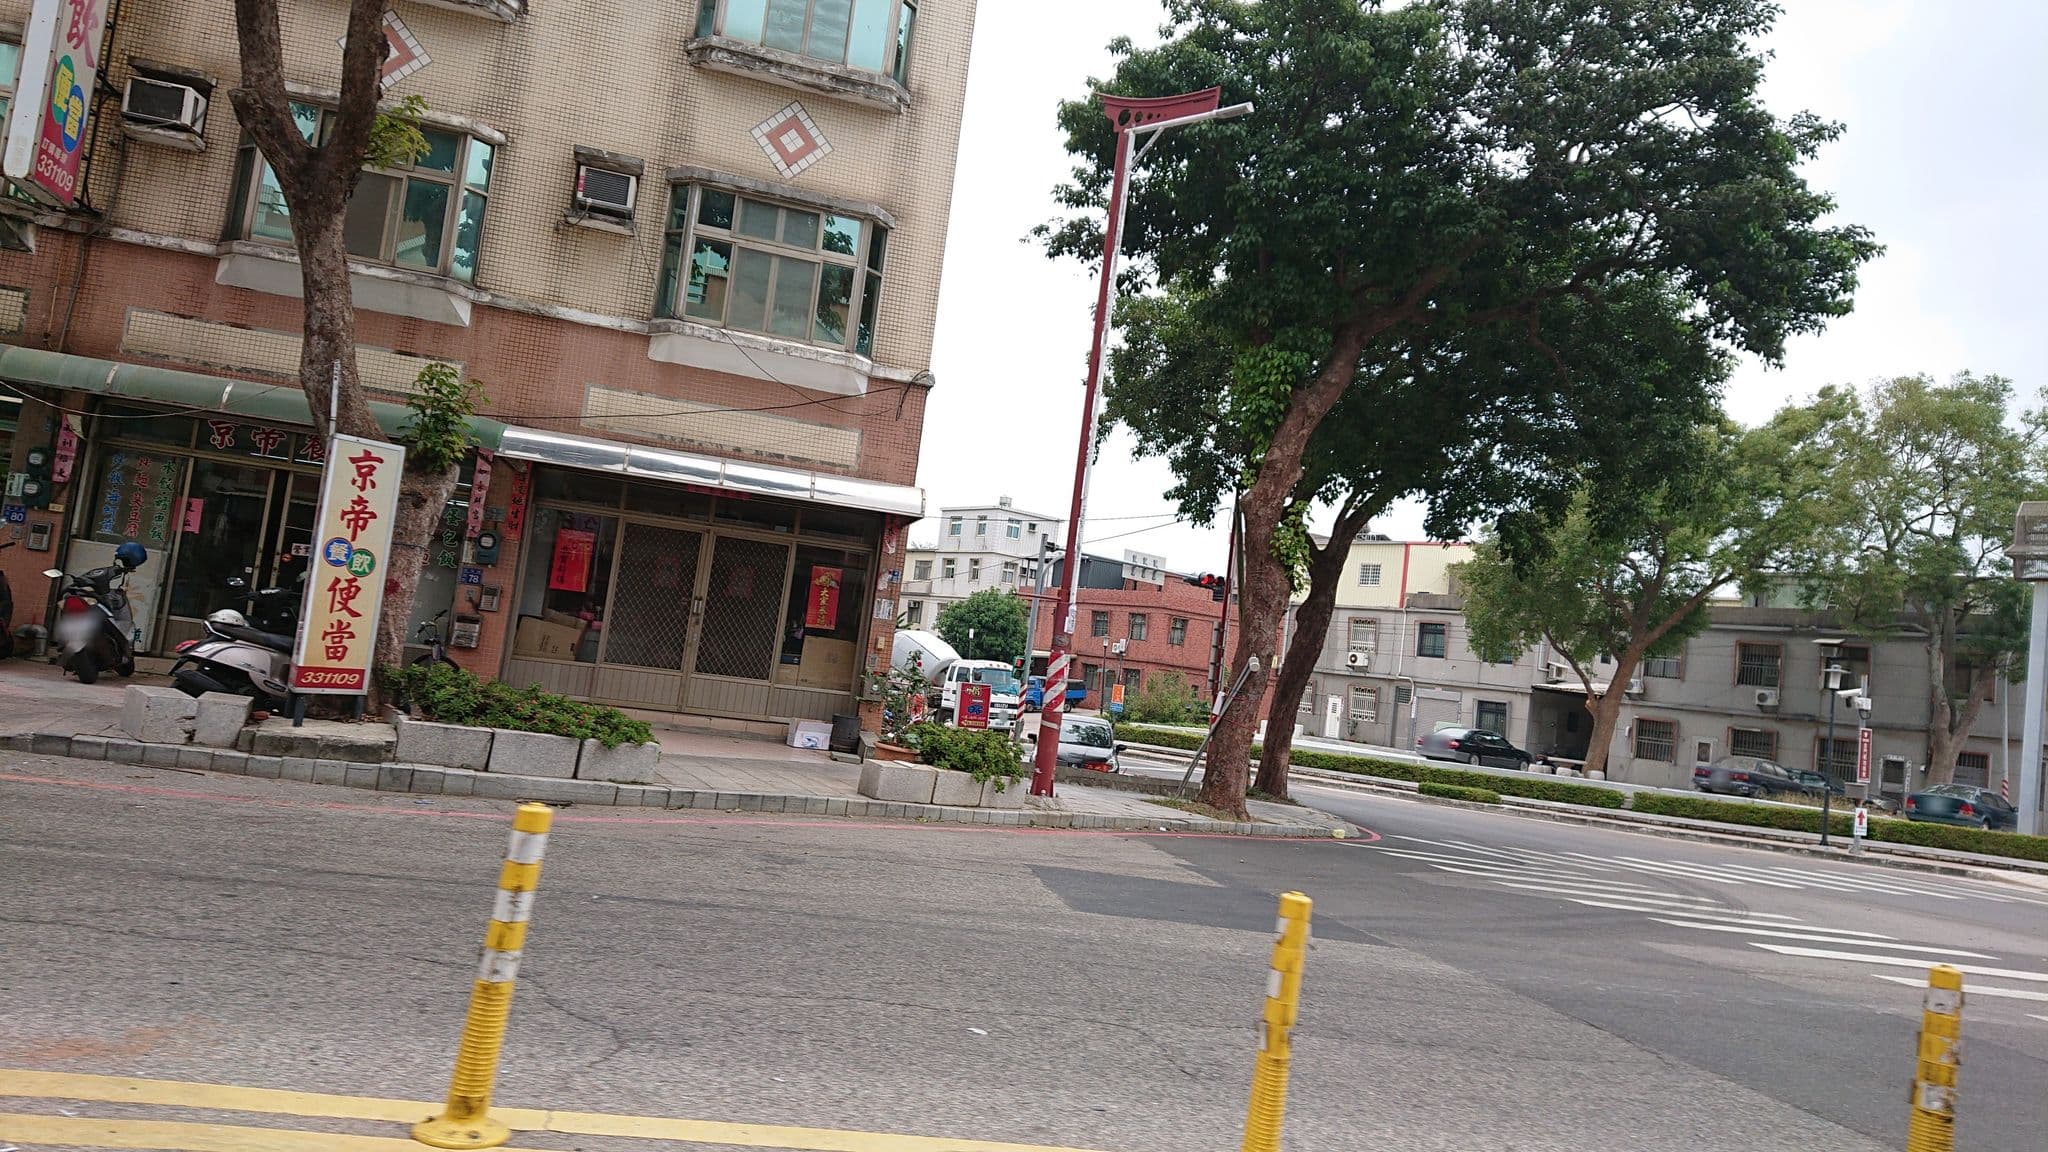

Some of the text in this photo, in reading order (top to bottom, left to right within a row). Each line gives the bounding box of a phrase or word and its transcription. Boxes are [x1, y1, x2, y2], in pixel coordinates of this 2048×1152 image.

[37, 153, 74, 192] 331109
[10, 512, 24, 521] 80
[437, 507, 460, 568] 蛋包飯
[321, 449, 384, 662] 京帝 餐飲 便當
[468, 574, 479, 583] 78
[301, 671, 360, 685] 331109
